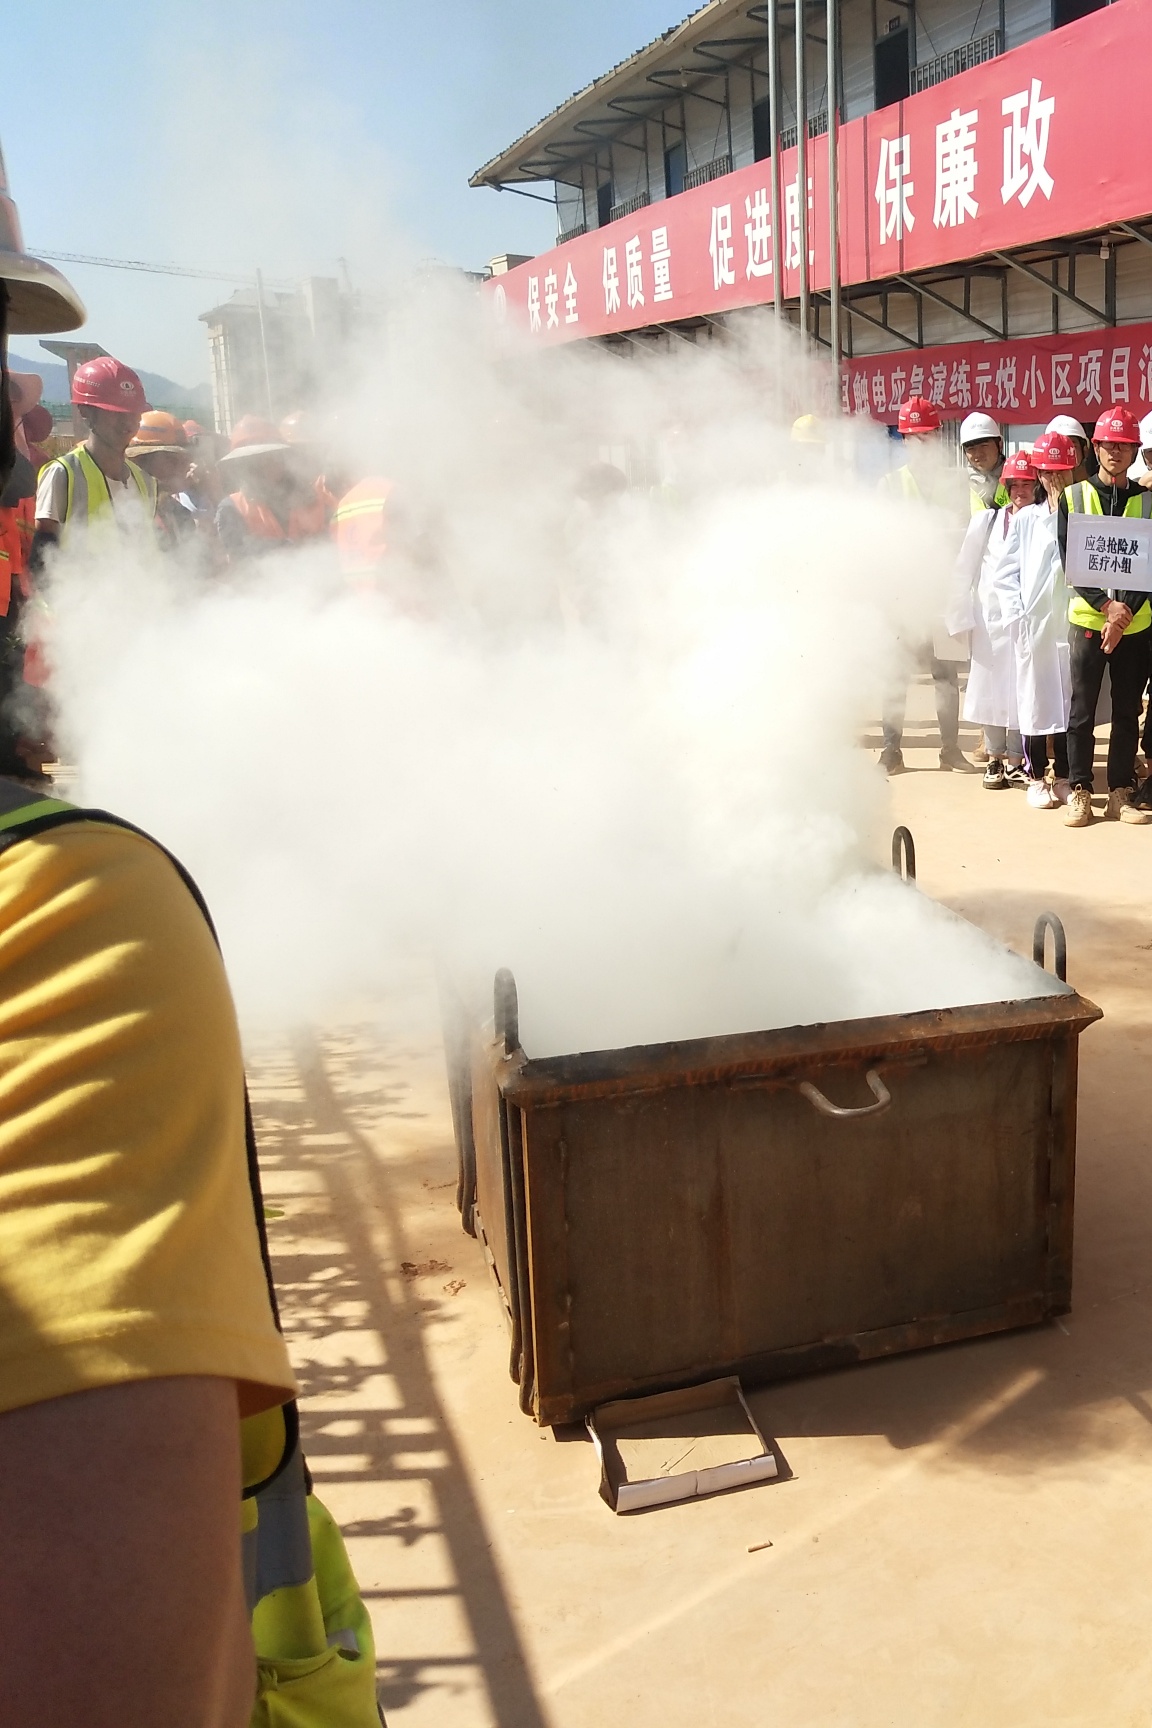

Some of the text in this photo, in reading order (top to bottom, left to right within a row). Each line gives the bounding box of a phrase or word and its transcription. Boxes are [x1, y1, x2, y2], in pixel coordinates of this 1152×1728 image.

[527, 262, 580, 332] 保安全
[602, 226, 673, 315] 保质量
[709, 173, 815, 291] 促进度
[874, 77, 1055, 245] 保廉政
[1084, 534, 1140, 557] 应急抢险及
[1088, 553, 1132, 574] 医疗小组
